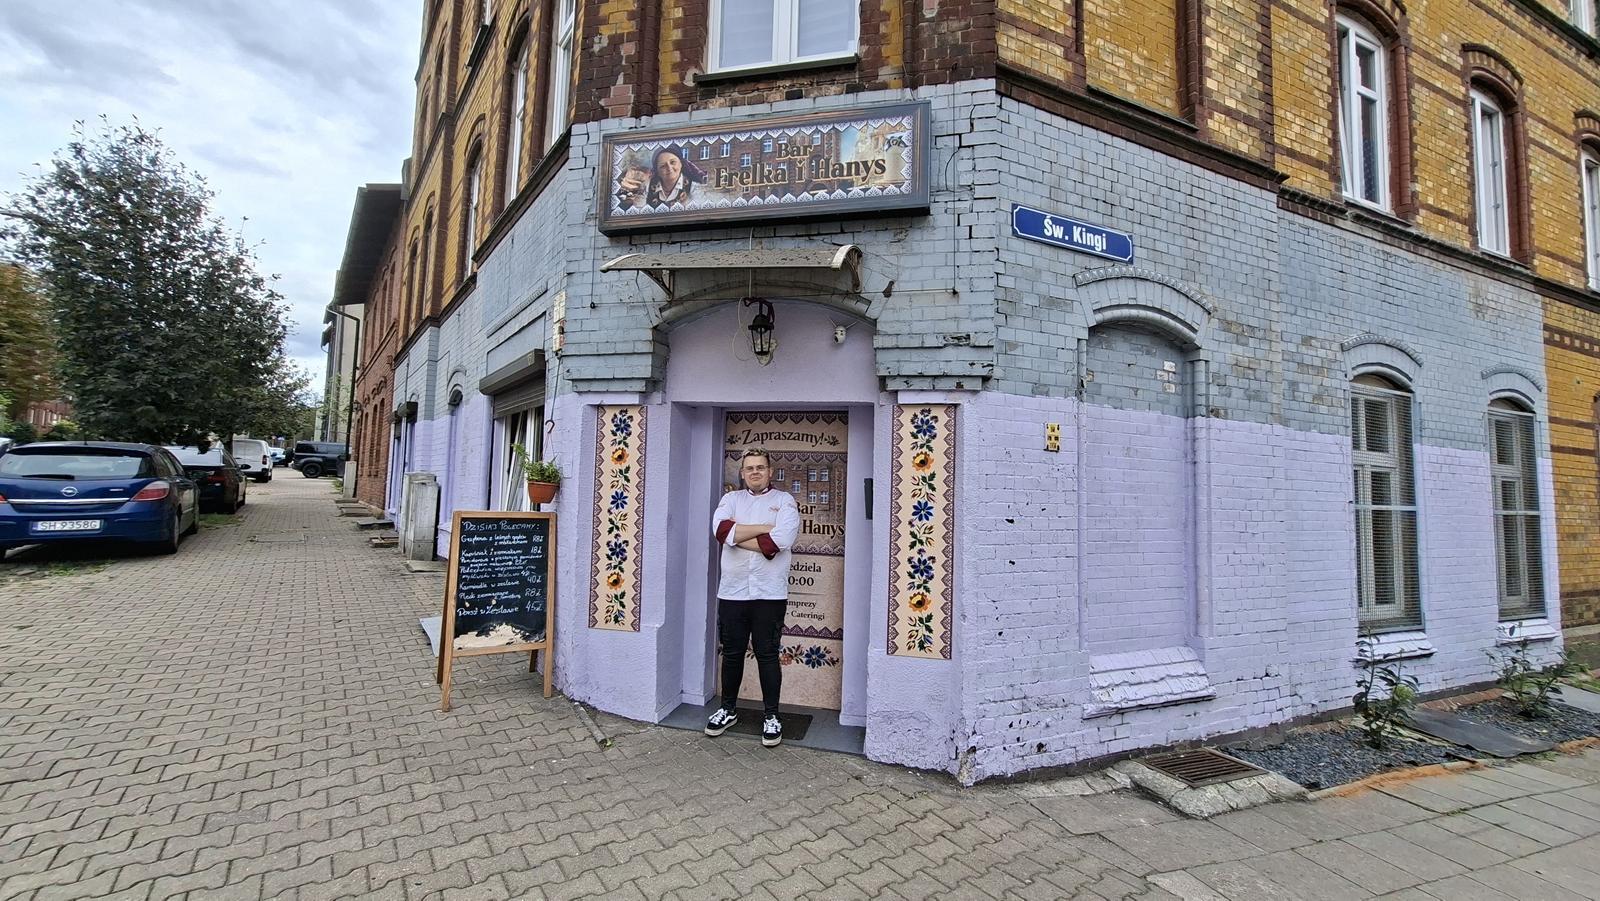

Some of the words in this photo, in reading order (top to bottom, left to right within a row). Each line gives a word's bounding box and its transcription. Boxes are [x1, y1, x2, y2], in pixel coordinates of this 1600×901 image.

[776, 142, 814, 160] Bar
[713, 164, 789, 190] Frelka
[796, 161, 805, 183] i
[813, 157, 887, 184] Hanys
[1043, 215, 1069, 240] Św.
[1073, 226, 1107, 251] Kingi
[741, 428, 825, 448] Zapraszamy!
[40, 521, 57, 530] SH
[61, 520, 98, 529] 9358G
[802, 519, 845, 539] Hanys
[790, 561, 822, 573] edziela
[788, 575, 815, 587] 0:00
[788, 600, 817, 610] mprezy
[791, 610, 825, 622] Cateringi
